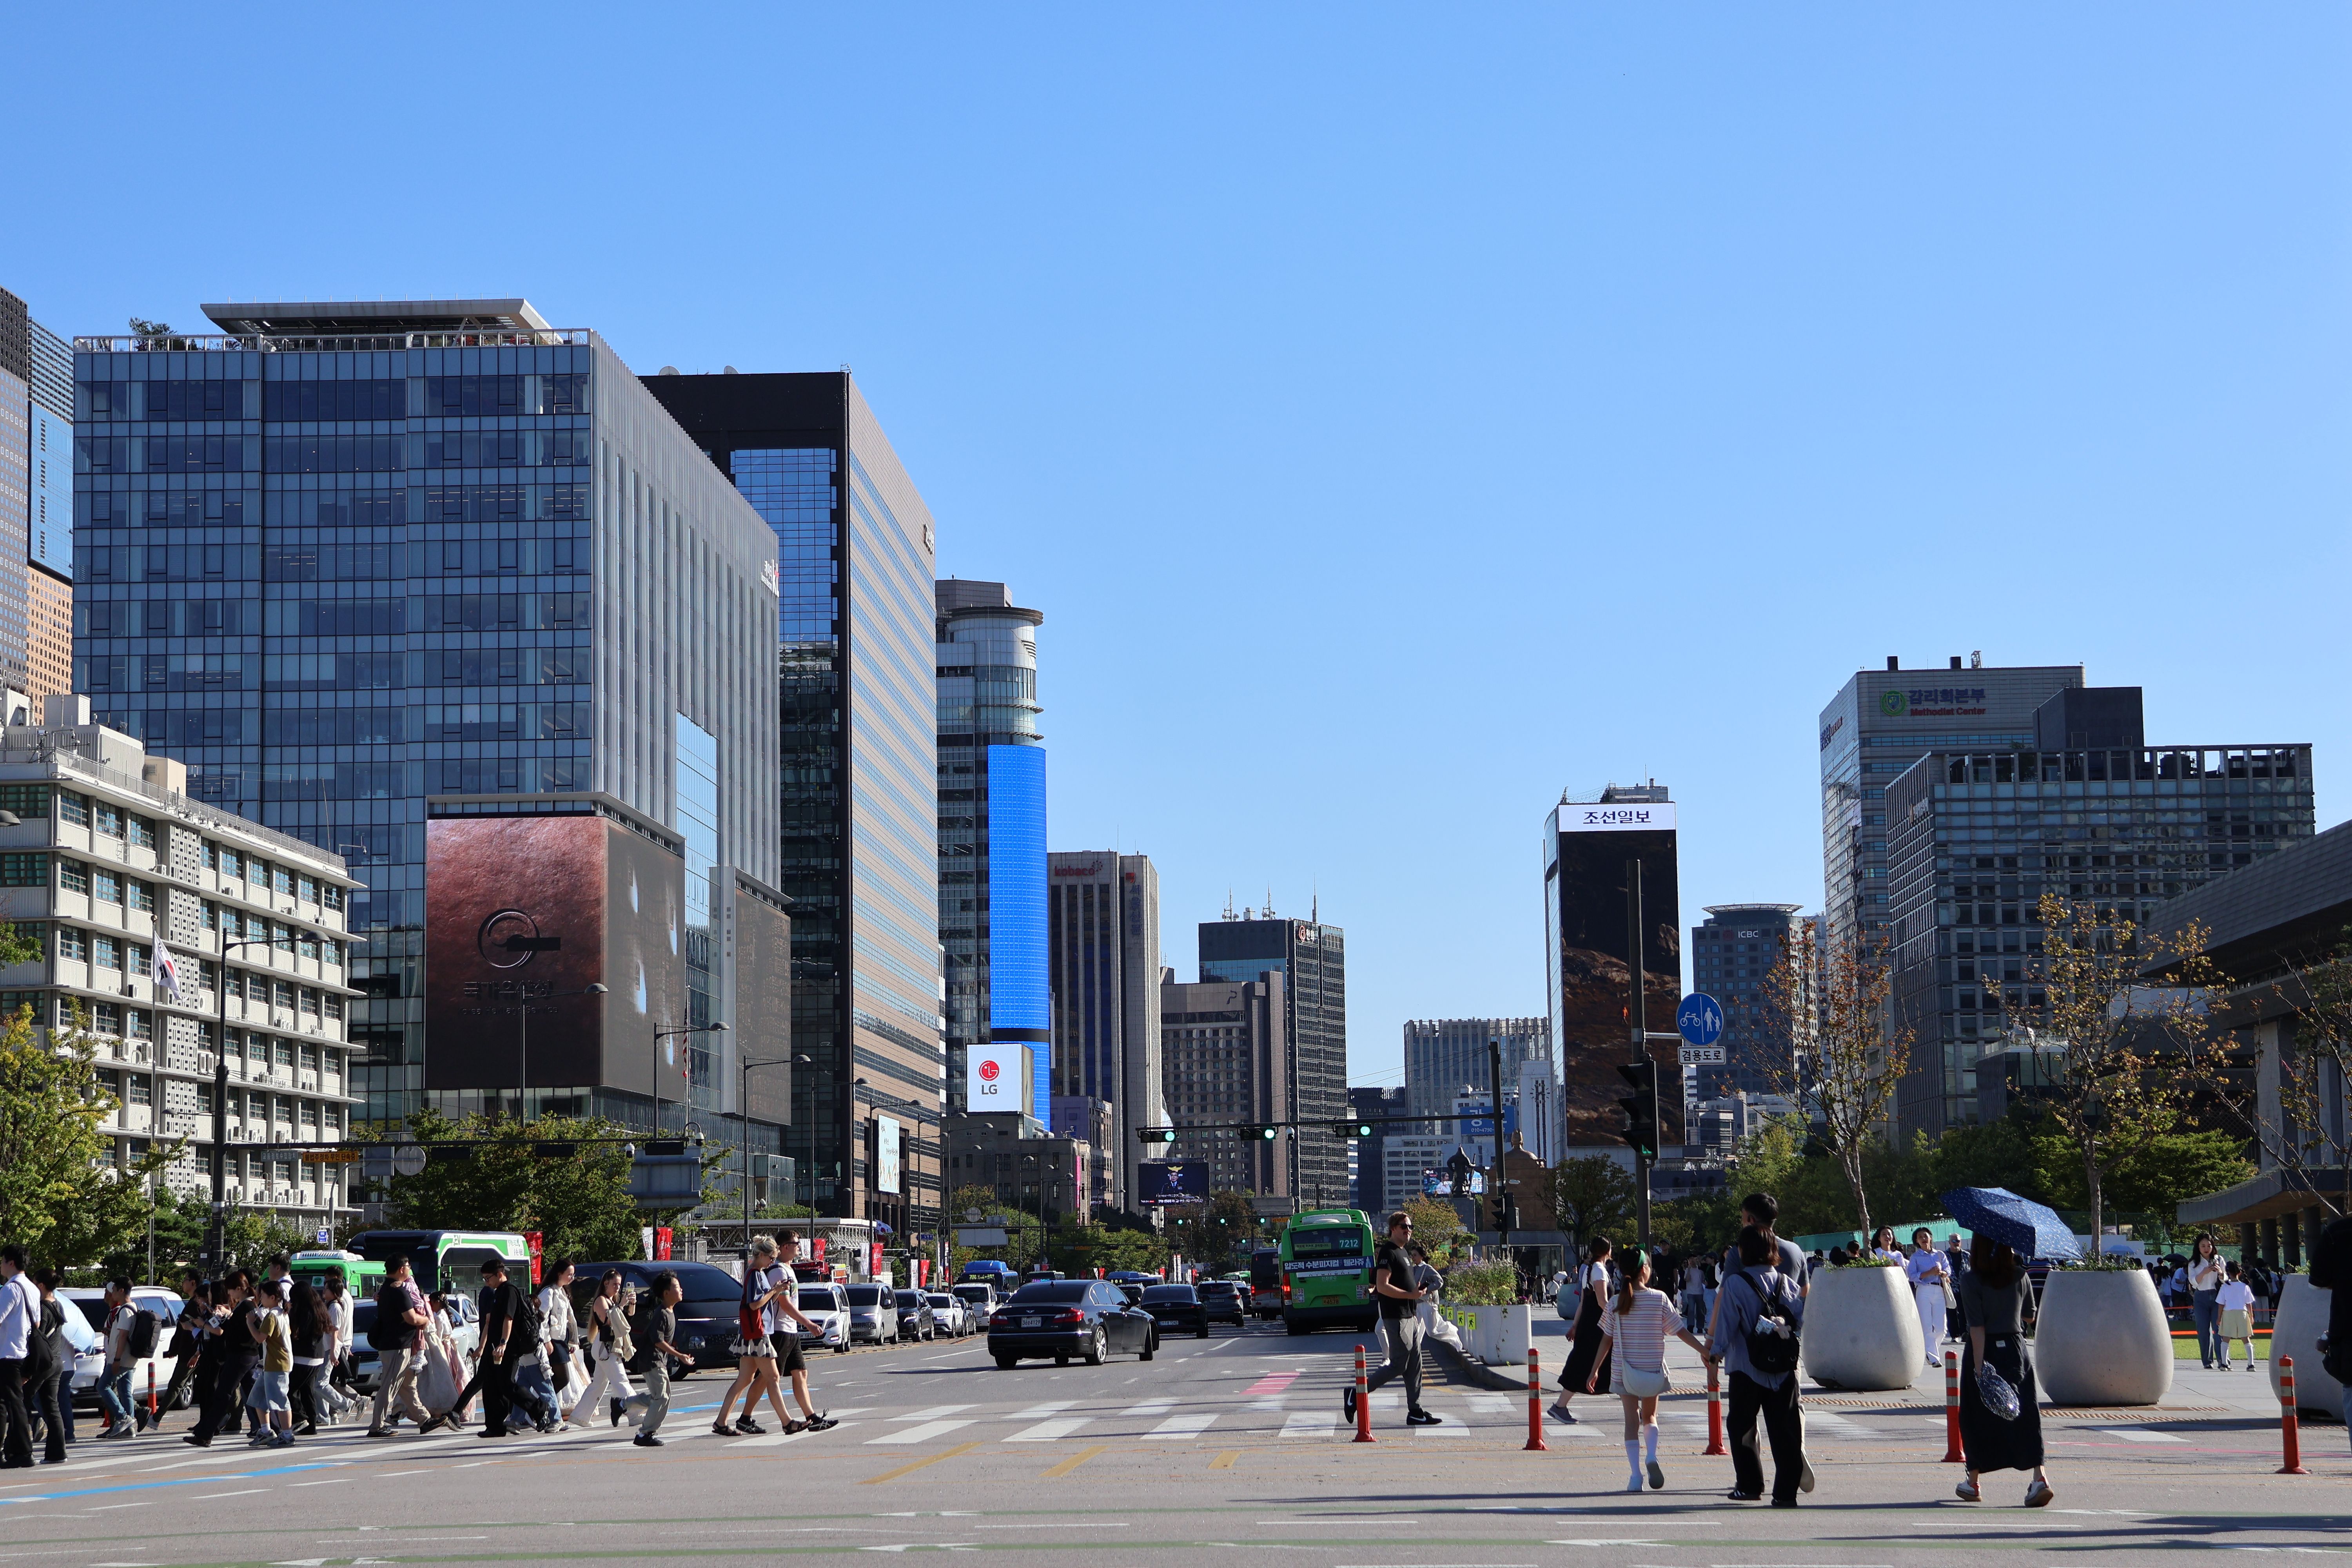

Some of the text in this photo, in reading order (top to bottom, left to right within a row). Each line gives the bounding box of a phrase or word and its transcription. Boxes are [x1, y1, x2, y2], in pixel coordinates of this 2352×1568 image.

[1909, 688, 1985, 704] 감리회본부
[1910, 708, 1954, 716] Methodist
[1583, 811, 1651, 824] 조선일보
[1054, 866, 1094, 877] kobaco
[1129, 885, 1142, 935] 서울신문
[1306, 929, 1314, 941] 한화
[1682, 1049, 1723, 1062] 겸용도로
[981, 1085, 998, 1095] LG
[1285, 1261, 1305, 1270] 압도적
[1306, 1259, 1339, 1268] 수분피지컬
